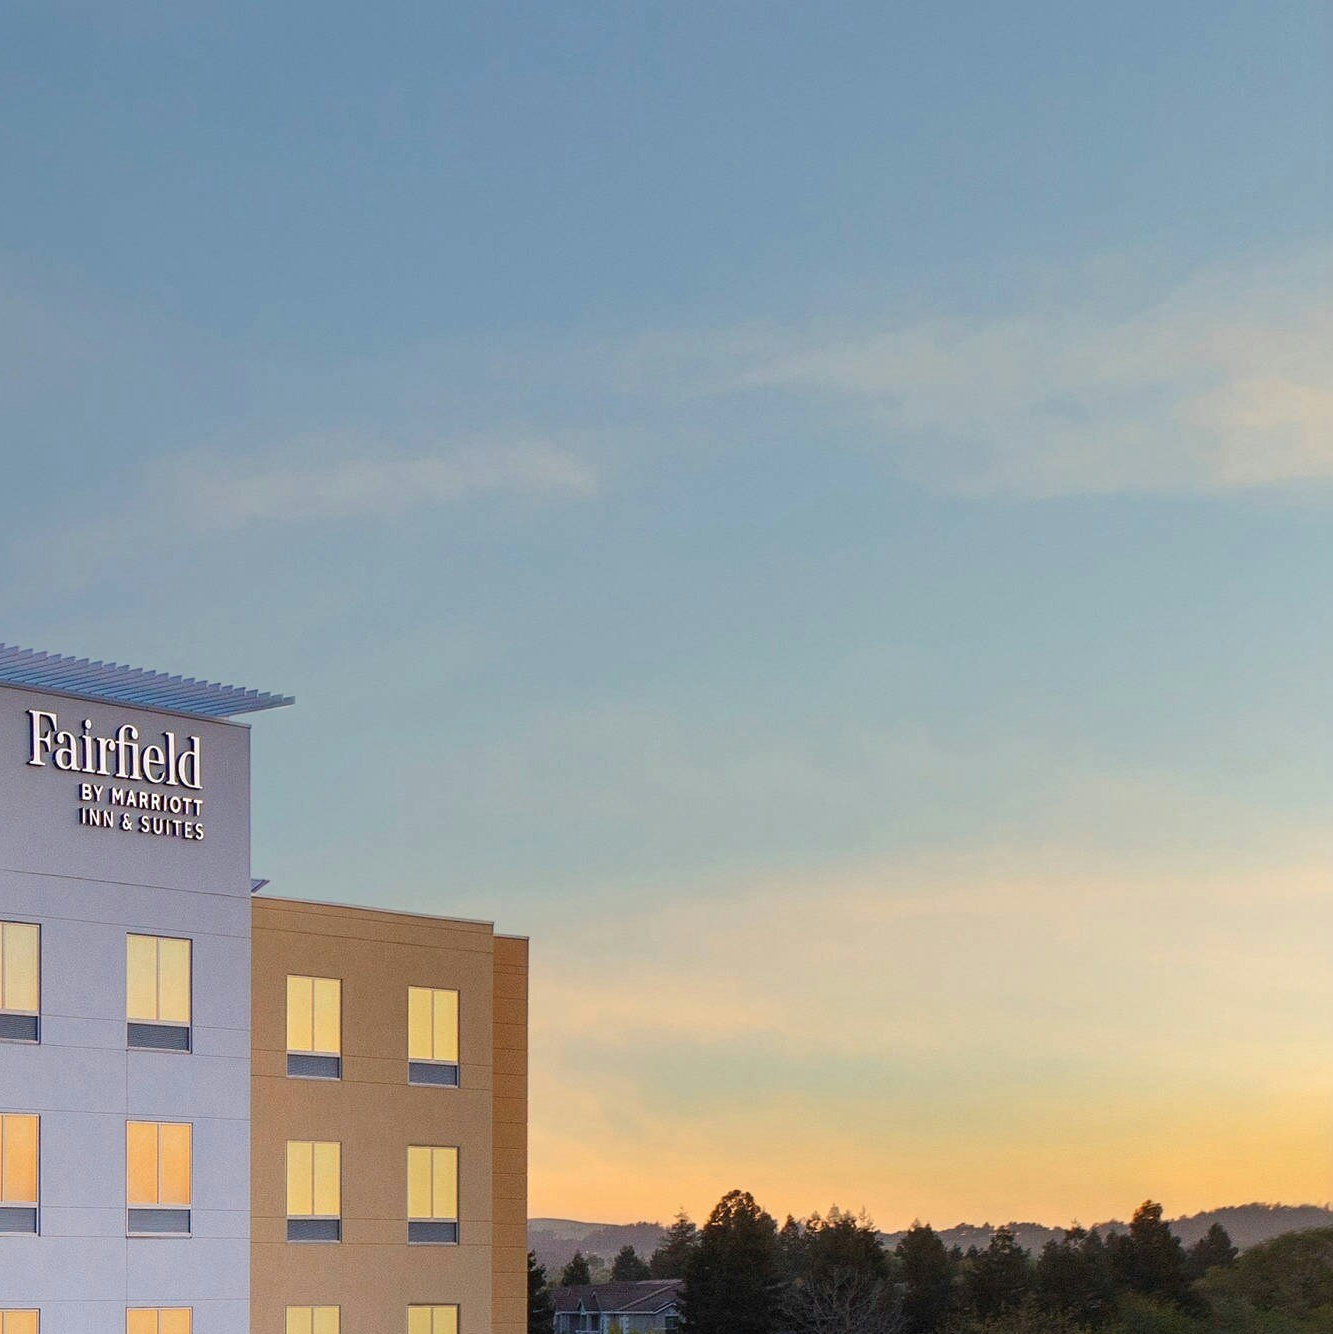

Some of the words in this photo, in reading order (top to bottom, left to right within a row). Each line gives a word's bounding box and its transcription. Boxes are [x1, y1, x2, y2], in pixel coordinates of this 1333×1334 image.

[28, 709, 203, 789] Fairfield
[79, 783, 104, 801] BY
[109, 786, 204, 816] MARRIOTT
[79, 807, 114, 828] INN
[122, 814, 133, 831] &
[139, 815, 204, 841] SUITES
